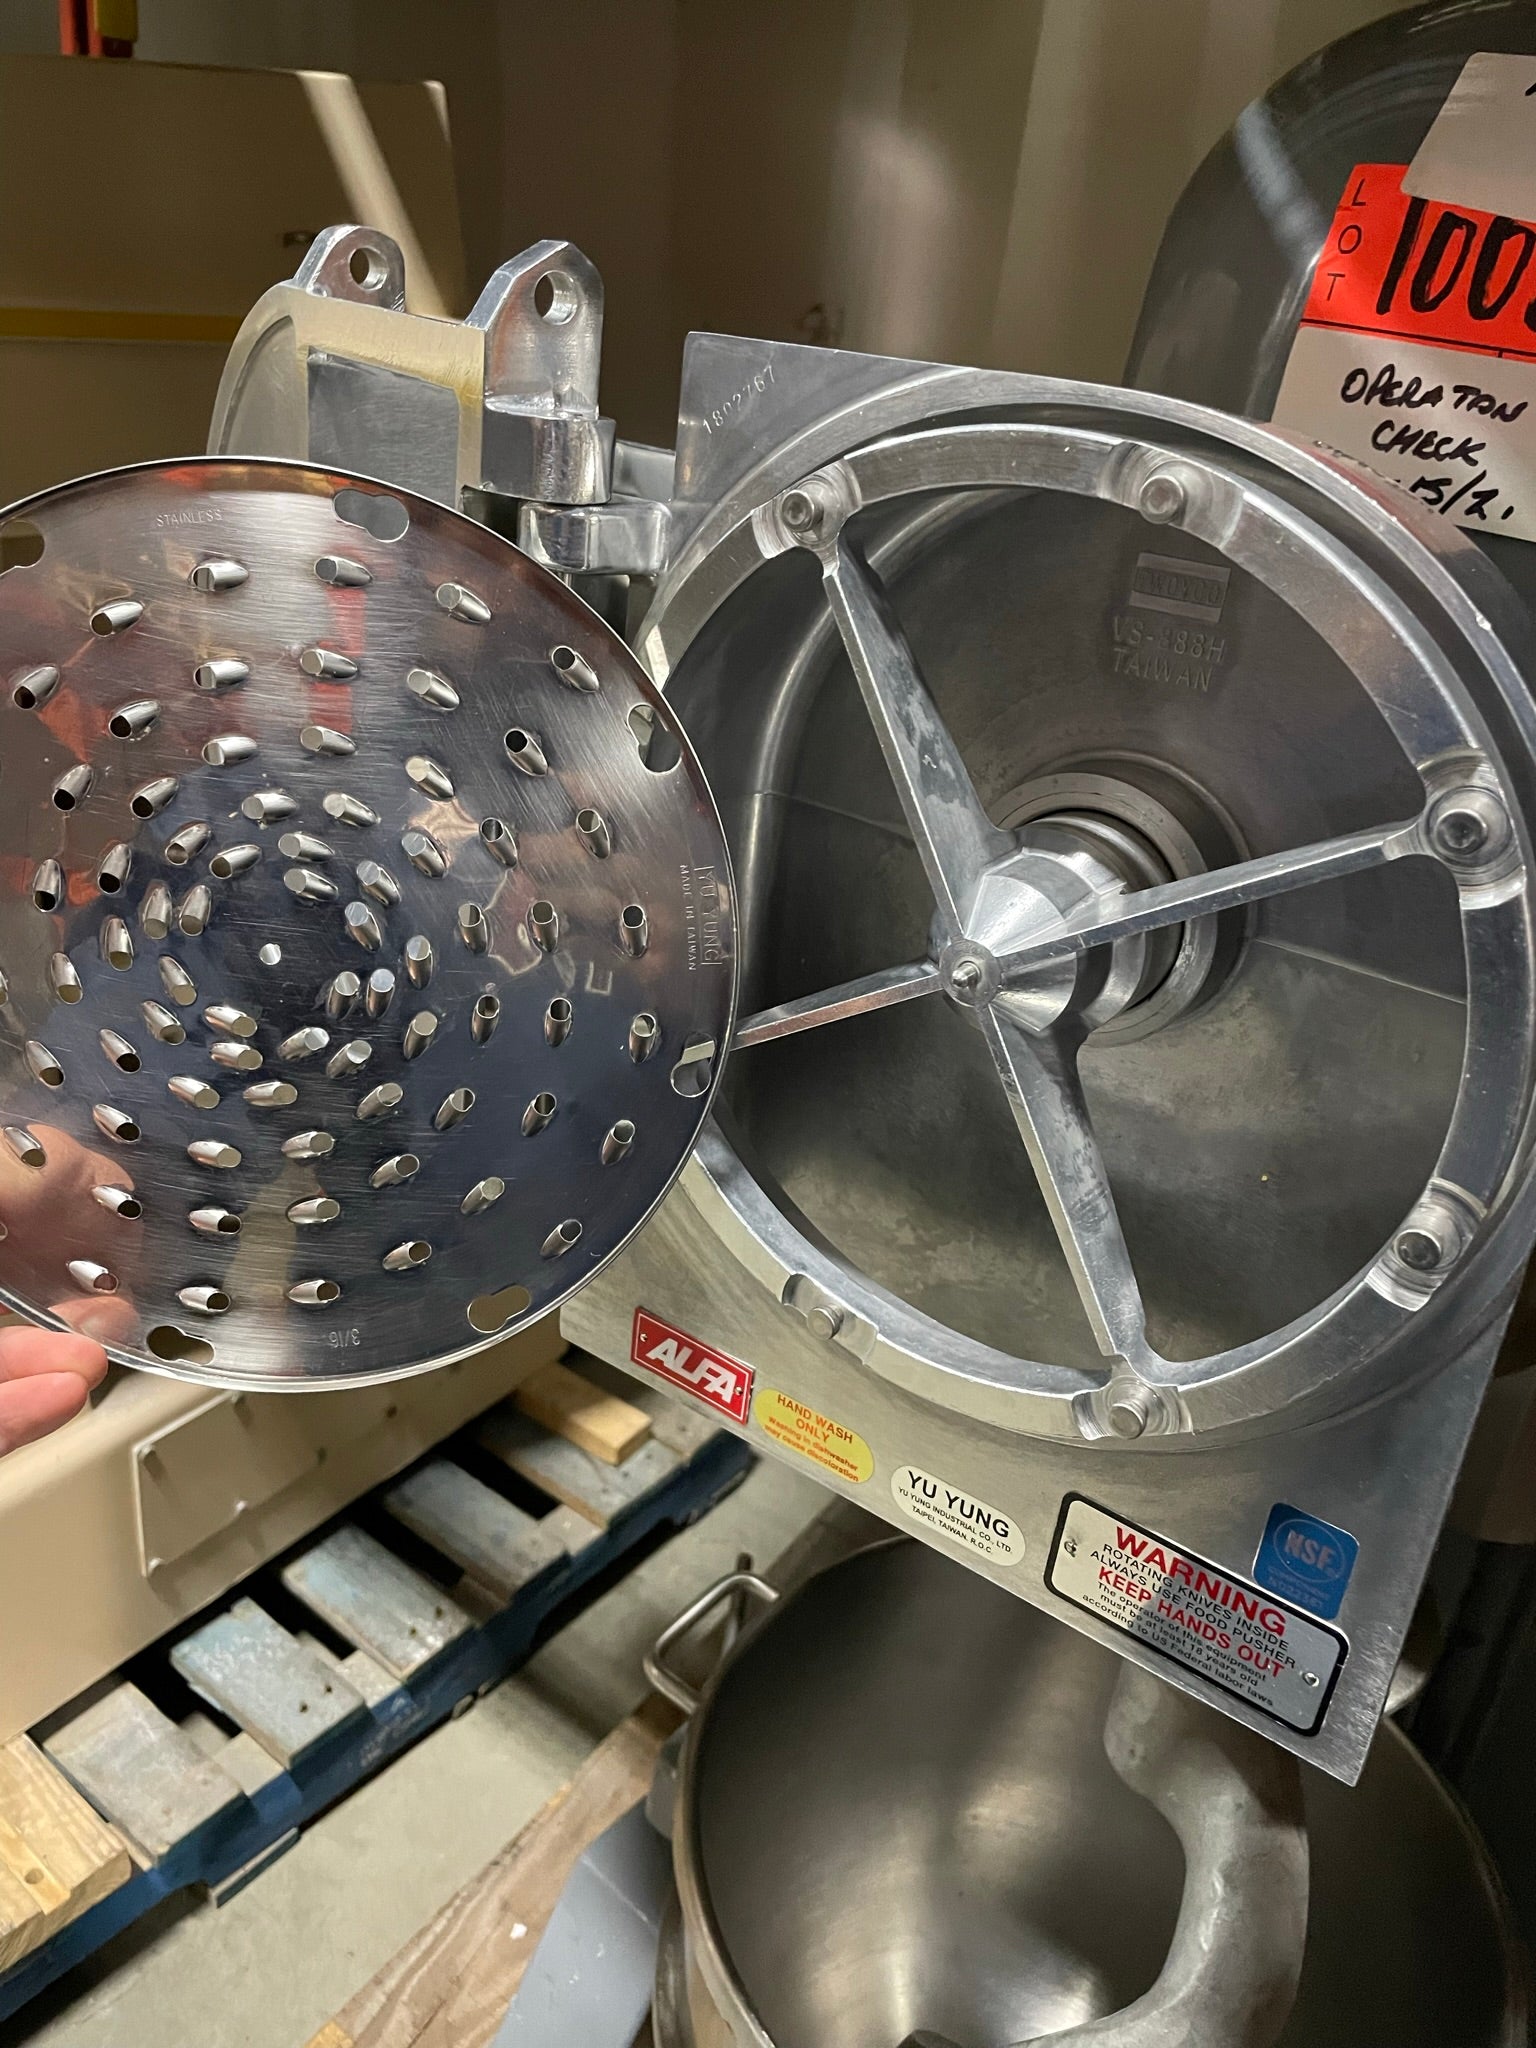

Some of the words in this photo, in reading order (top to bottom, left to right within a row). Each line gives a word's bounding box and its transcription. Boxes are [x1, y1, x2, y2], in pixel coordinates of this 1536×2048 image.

[1376, 195, 1536, 333] 100
[1371, 419, 1487, 467] CHECK
[156, 508, 223, 527] STAINLESS
[1113, 647, 1213, 693] TAIWAN
[687, 926, 697, 971] TAIWAN
[645, 1337, 738, 1404] ALFA
[777, 1394, 812, 1420] HAND
[815, 1415, 853, 1444] WASH
[795, 1418, 830, 1442] ONLY
[807, 1447, 859, 1482] discoloration
[812, 1439, 858, 1472] dishwasher
[898, 1486, 909, 1497] YU
[910, 1493, 931, 1509] YUNG
[932, 1506, 977, 1534] INDUSTRIAL
[908, 1470, 937, 1499] YU
[945, 1490, 1010, 1538] YUNG
[1284, 1529, 1337, 1570] NSF
[1090, 1550, 1147, 1586] ALWAYS
[1152, 1582, 1181, 1605] USE
[1185, 1602, 1228, 1630] FOOD
[1232, 1627, 1296, 1669] PUSHER
[1103, 1543, 1173, 1588] ROTATING
[1178, 1585, 1232, 1620] KNIVES
[1236, 1617, 1289, 1652] INSIDE
[1116, 1525, 1287, 1637] WARNING
[1082, 1594, 1134, 1629] according
[1137, 1625, 1148, 1635] to
[1151, 1632, 1167, 1646] US
[1170, 1643, 1212, 1672] Federal
[1214, 1666, 1244, 1689] labor
[1247, 1686, 1273, 1706] laws
[1098, 1566, 1152, 1602] KEEP
[1157, 1600, 1232, 1649] HANDS
[1237, 1645, 1285, 1678] OUT
[1098, 1581, 1116, 1597] The
[1119, 1596, 1165, 1625] operator
[1168, 1622, 1180, 1632] of
[1183, 1630, 1203, 1647] this
[1206, 1644, 1266, 1681] equipment
[1100, 1594, 1127, 1612] must
[1129, 1608, 1143, 1621] be
[1145, 1619, 1157, 1630] at
[1160, 1626, 1186, 1646] least
[1190, 1643, 1203, 1655] 18
[1206, 1654, 1236, 1675] years
[1239, 1672, 1258, 1686] old
